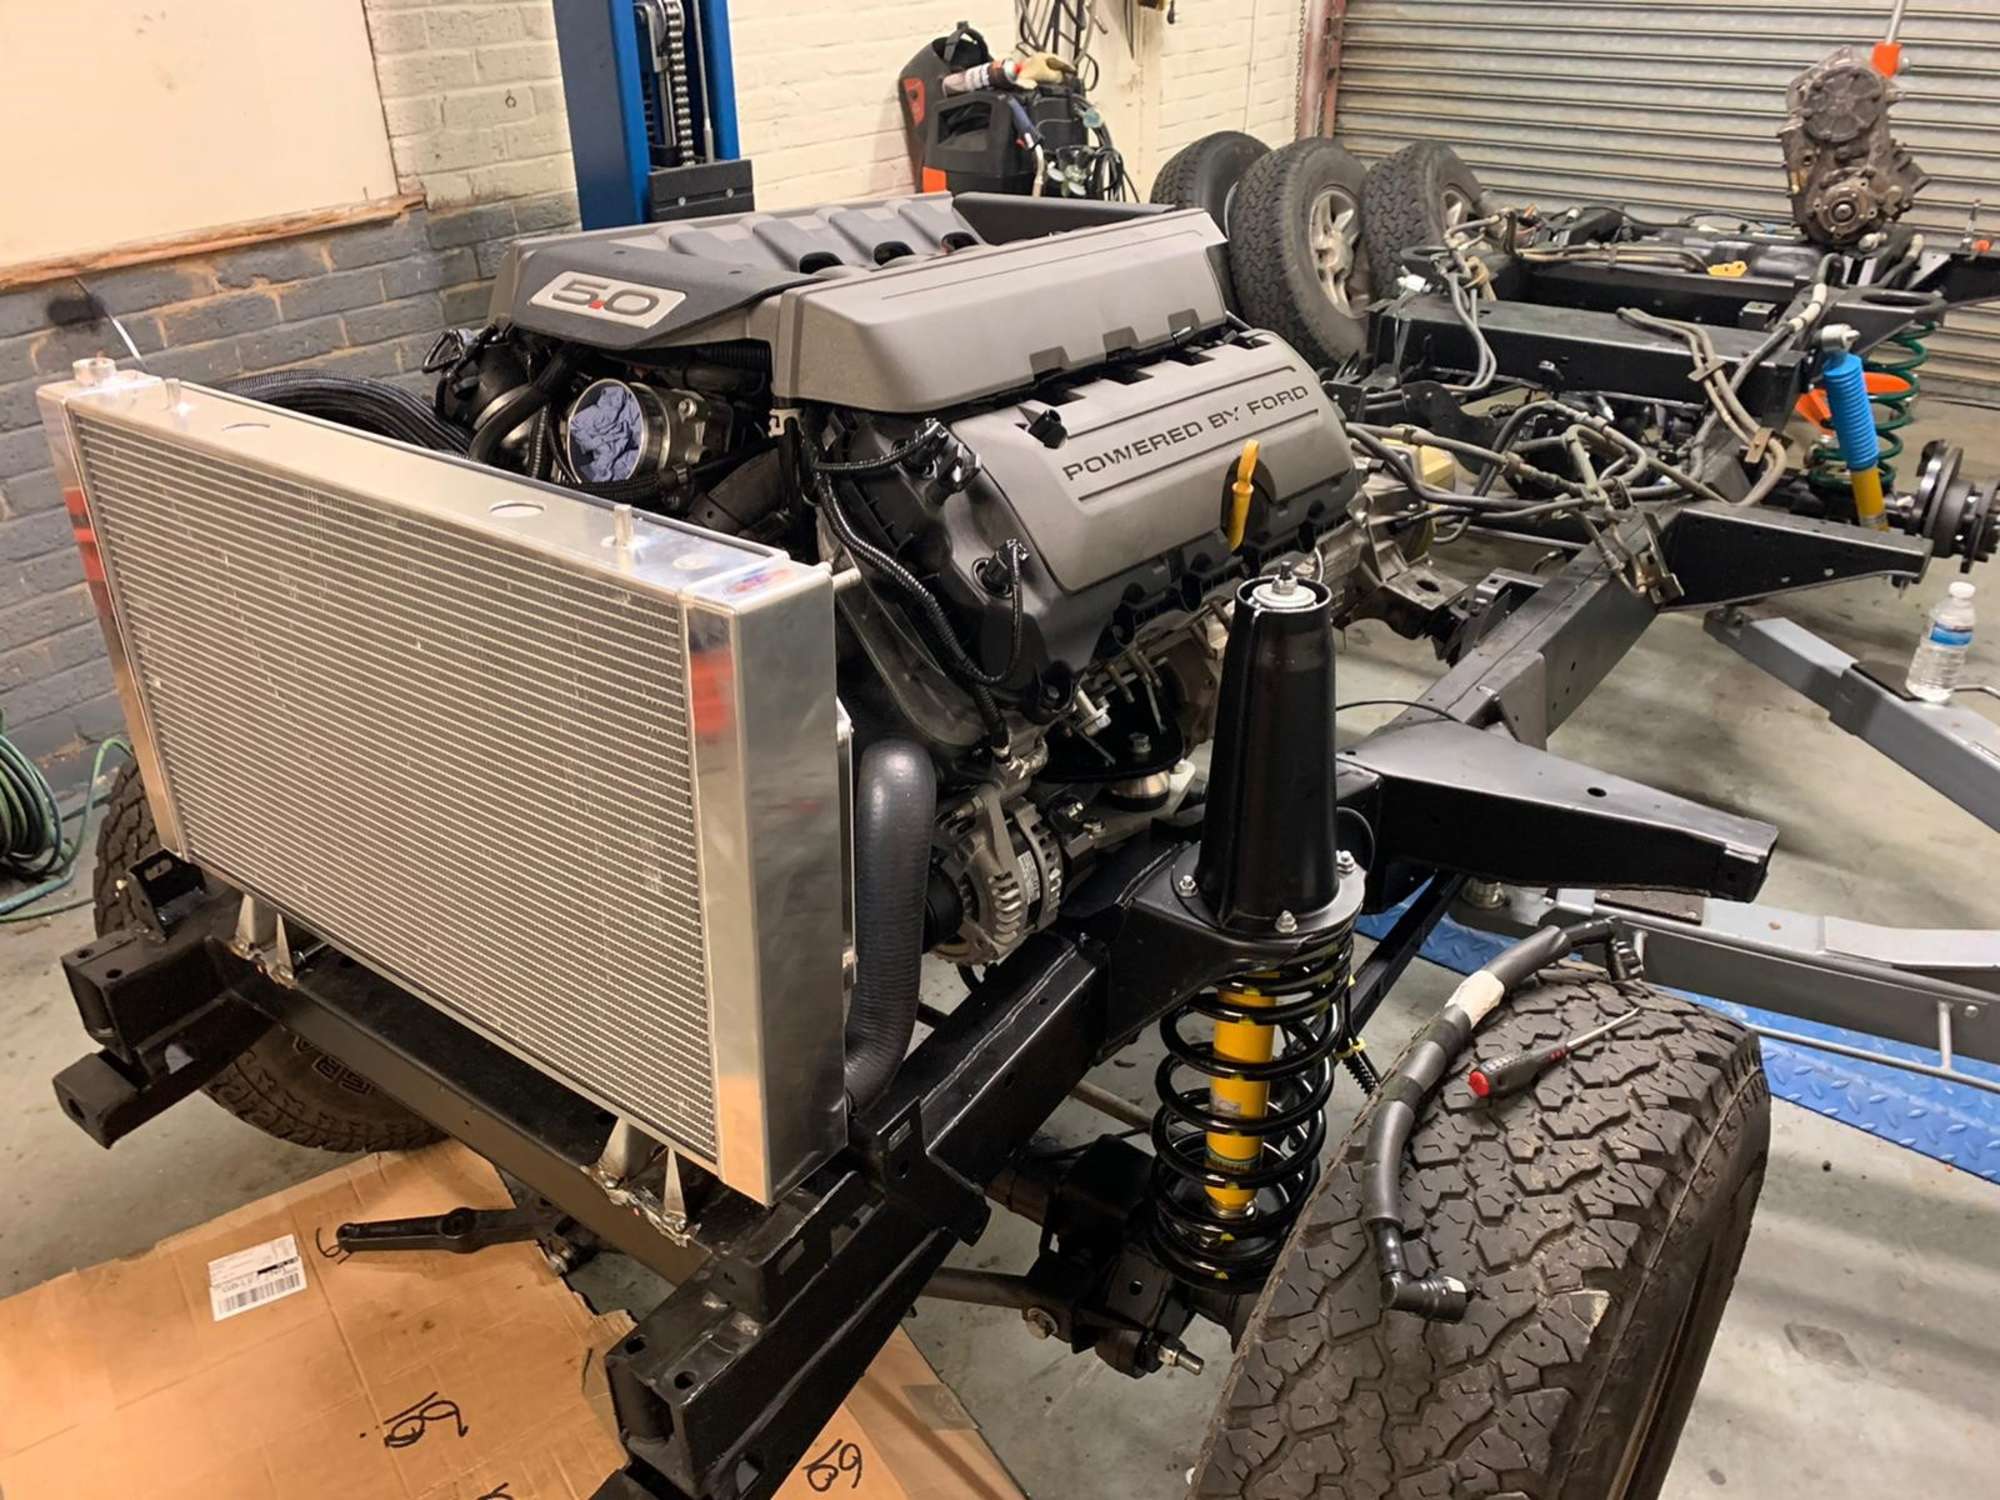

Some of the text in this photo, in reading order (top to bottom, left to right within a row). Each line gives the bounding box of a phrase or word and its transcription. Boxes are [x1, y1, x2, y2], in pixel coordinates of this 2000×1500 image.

[552, 279, 660, 316] 5.0
[1062, 385, 1309, 481] POWERED BY FORD
